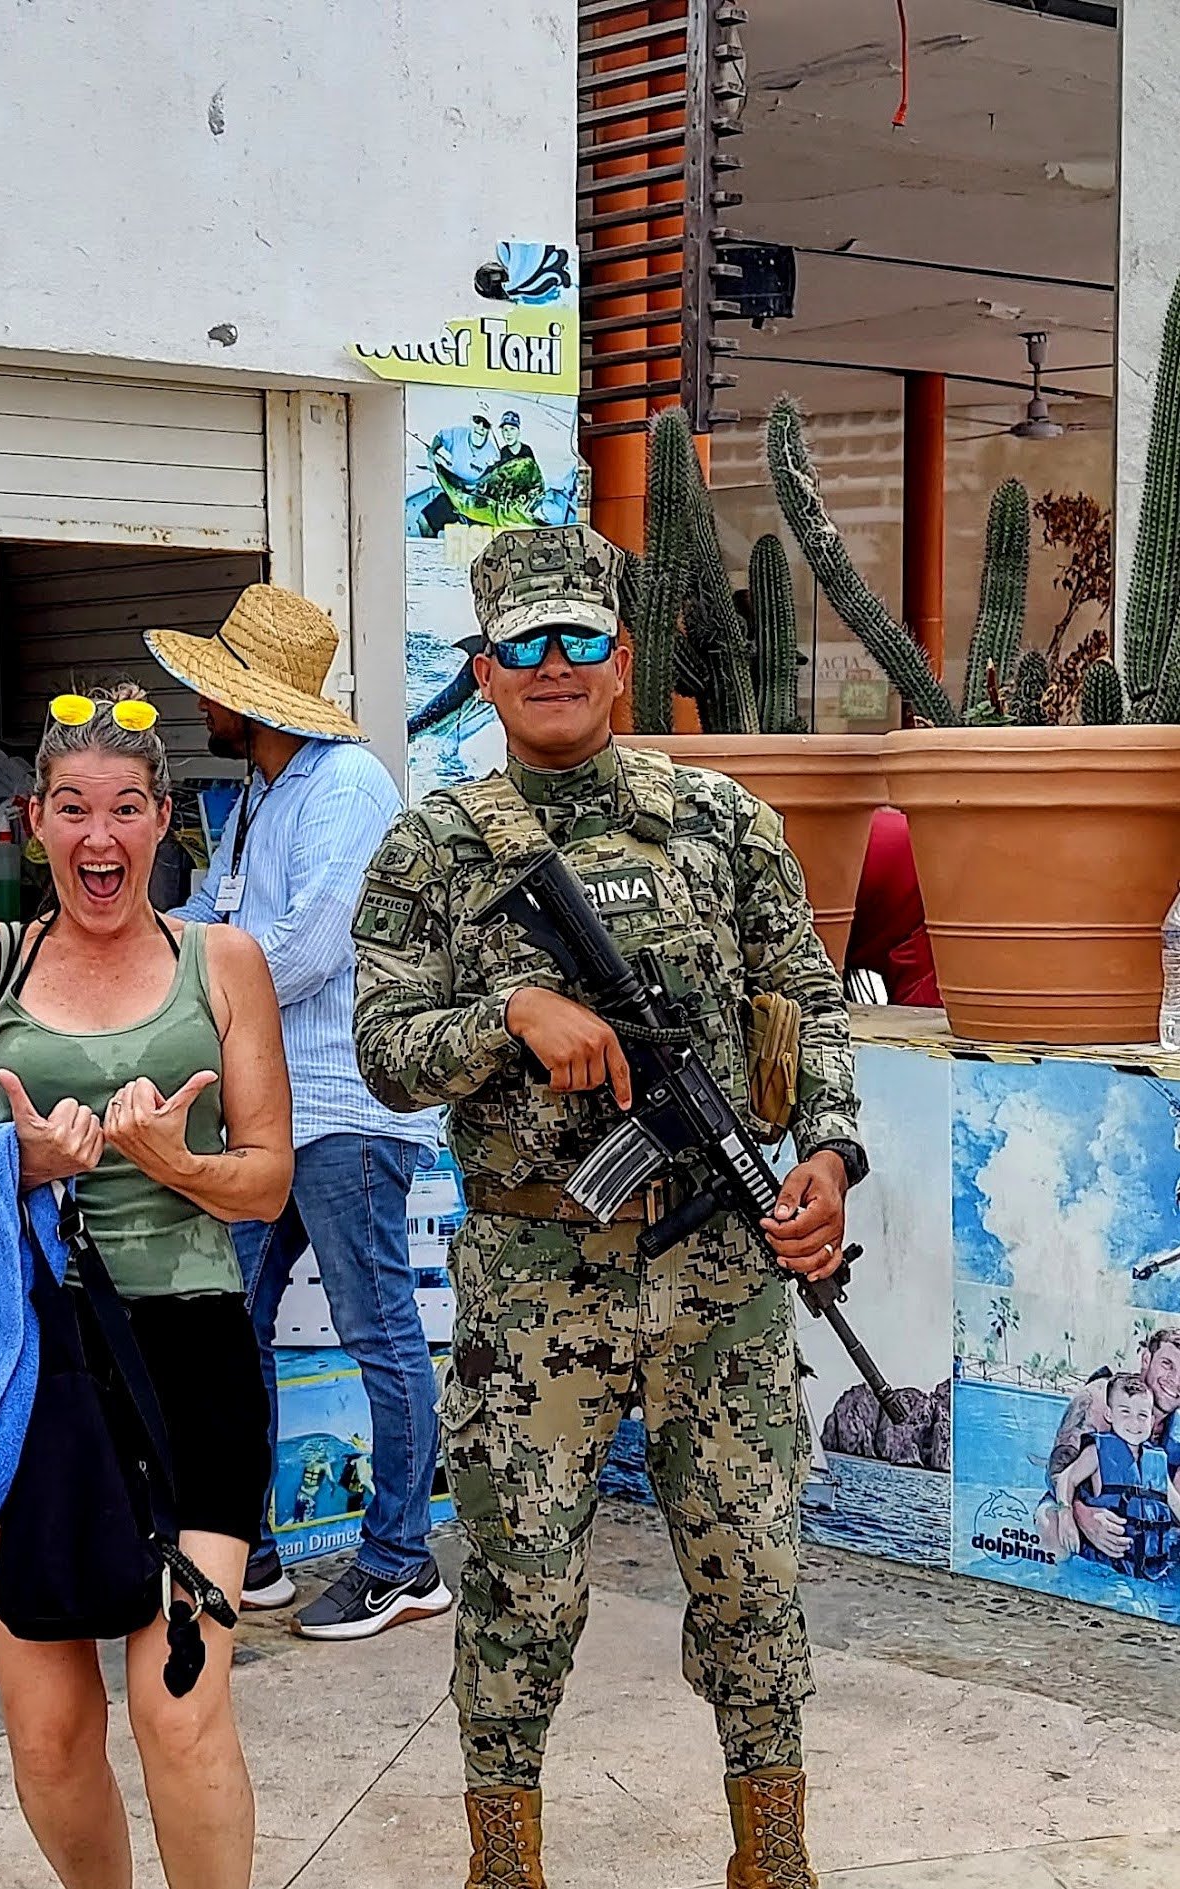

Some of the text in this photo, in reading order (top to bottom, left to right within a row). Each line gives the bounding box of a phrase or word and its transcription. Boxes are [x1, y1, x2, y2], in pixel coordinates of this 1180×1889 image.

[480, 318, 562, 375] Taxi
[971, 1532, 1057, 1566] dolphins
[1001, 1527, 1041, 1545] cabo
